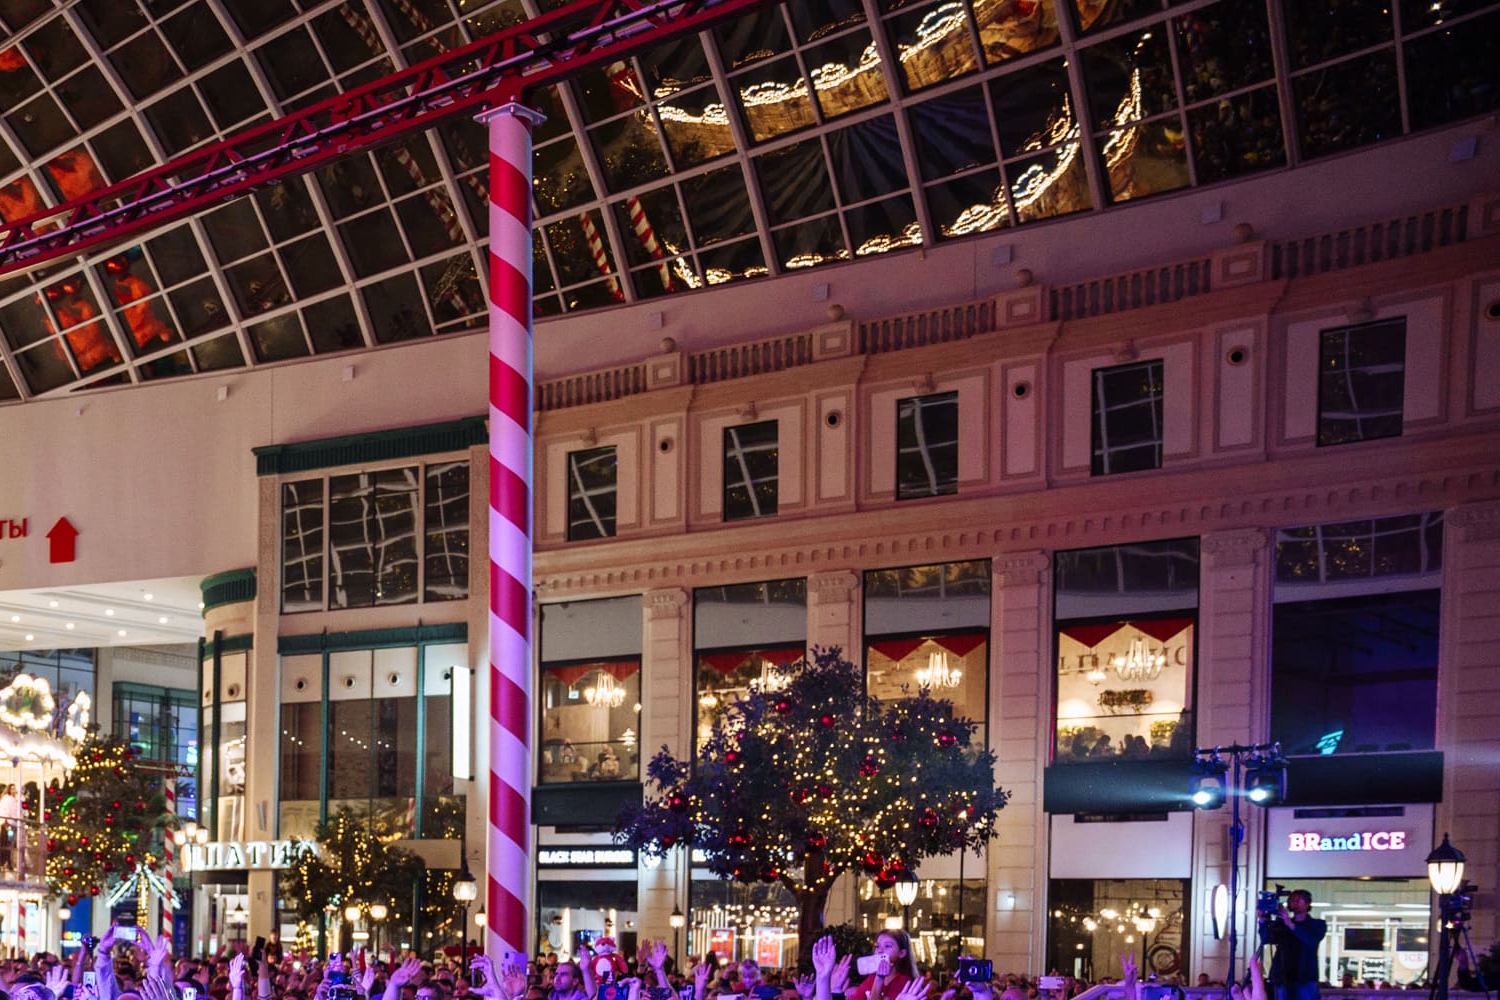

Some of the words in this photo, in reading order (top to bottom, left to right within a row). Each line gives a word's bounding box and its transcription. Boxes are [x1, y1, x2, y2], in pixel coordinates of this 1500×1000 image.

[1288, 831, 1406, 851] BRandICE
[538, 851, 570, 863] BLACK
[570, 851, 594, 863] STAR
